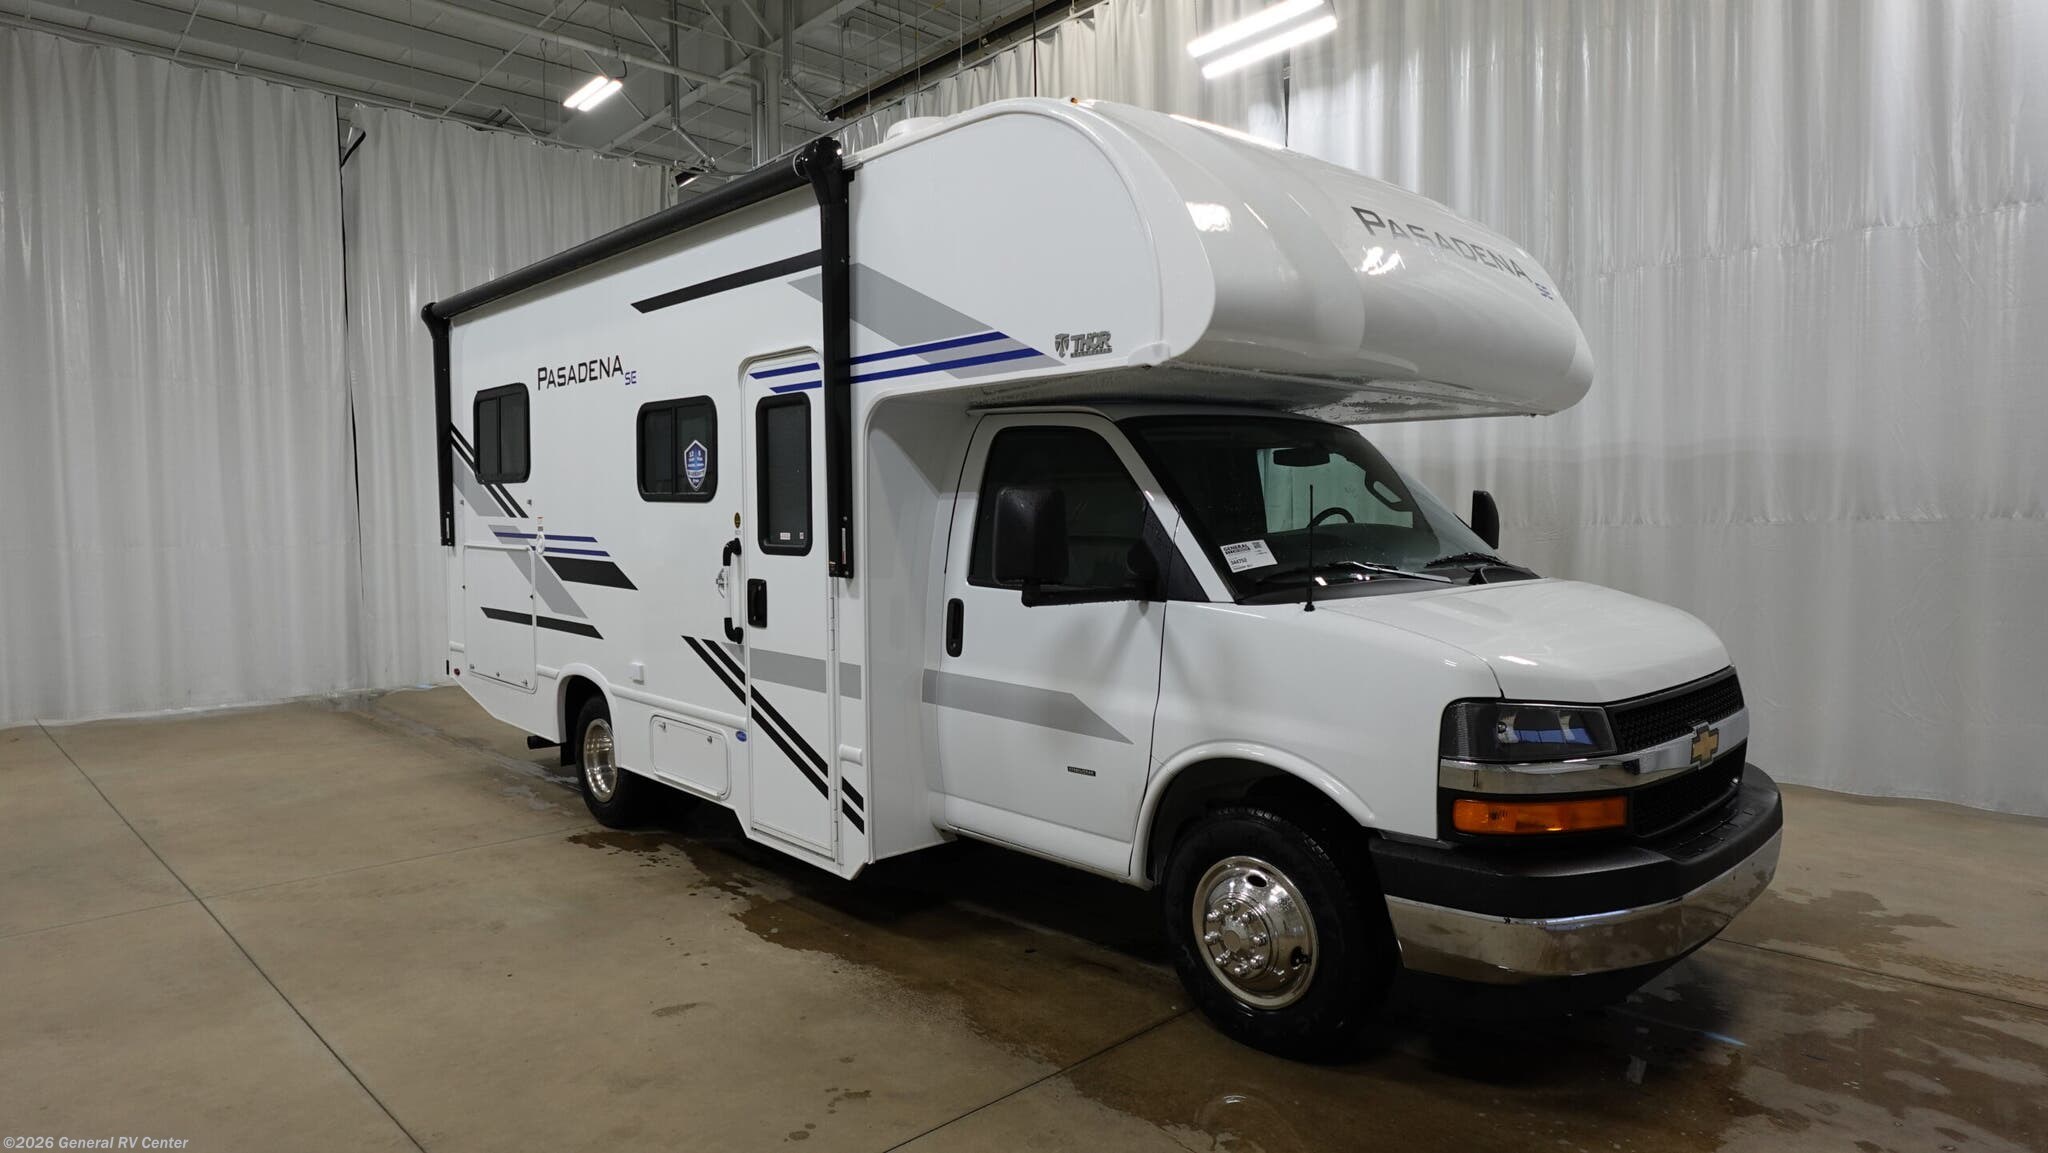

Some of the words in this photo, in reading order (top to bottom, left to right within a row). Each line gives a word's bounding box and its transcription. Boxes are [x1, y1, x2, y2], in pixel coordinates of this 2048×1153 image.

[1351, 206, 1533, 283] PASADENA
[1070, 330, 1112, 354] THOR
[537, 354, 624, 391] PASADENA
[624, 370, 637, 386] SE
